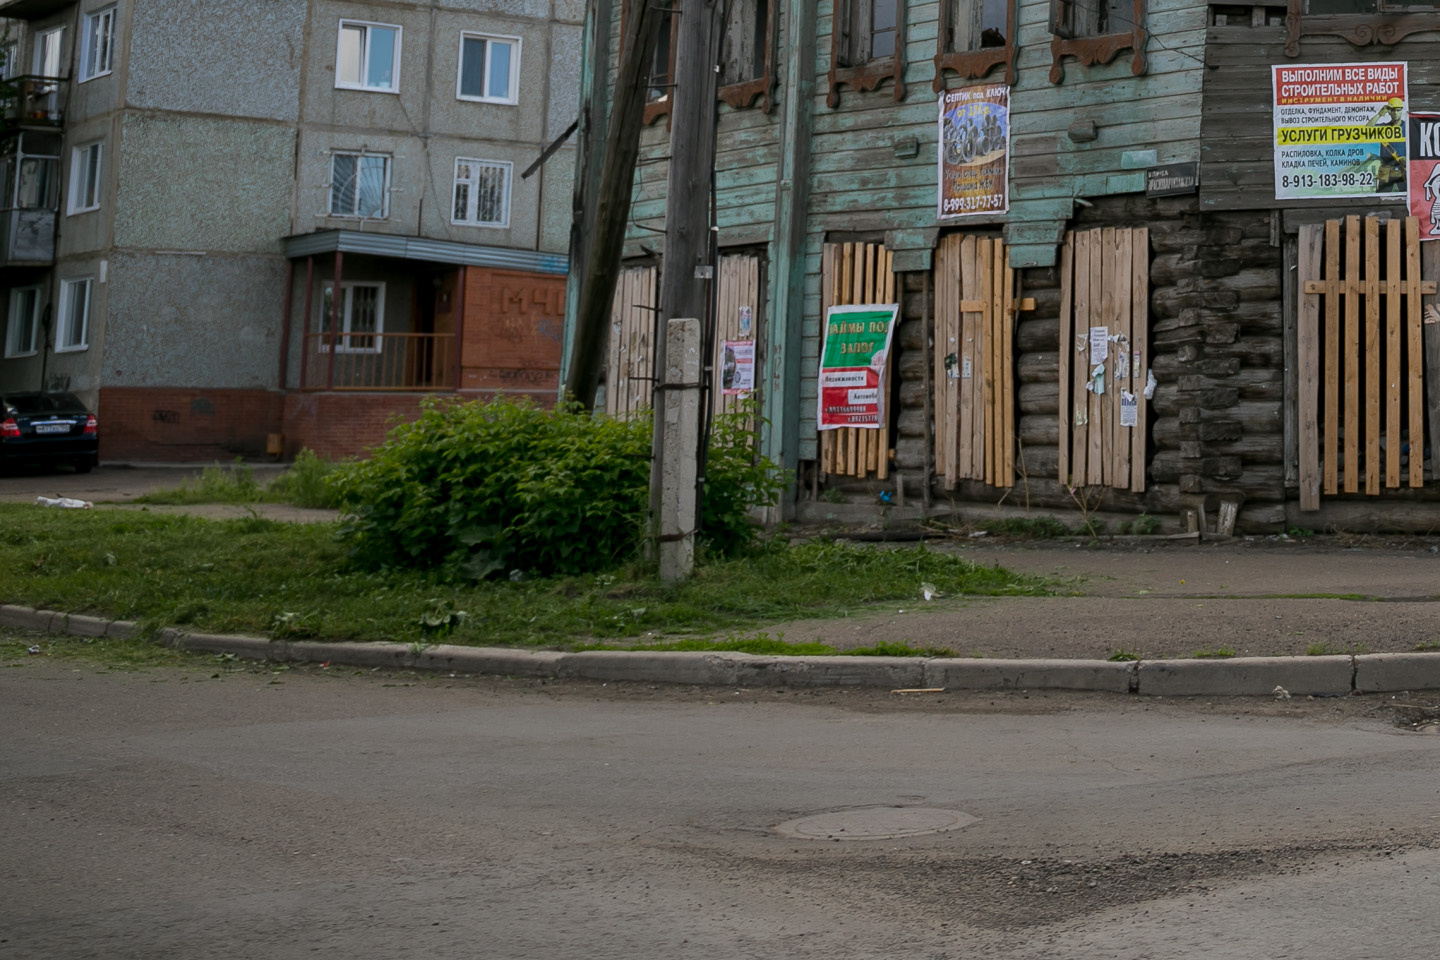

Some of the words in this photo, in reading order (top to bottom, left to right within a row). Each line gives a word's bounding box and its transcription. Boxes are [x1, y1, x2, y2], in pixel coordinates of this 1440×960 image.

[1282, 69, 1342, 82] ВЫПОЛНИМ
[1345, 68, 1364, 80] ВСЕ
[1368, 68, 1398, 81] ВИДЫ
[1282, 83, 1364, 97] СТРОИТЕЛЬНЫХ
[1366, 82, 1399, 94] РАБОТ
[946, 92, 970, 103] СЕПТИК
[1280, 108, 1306, 116] ОТДЕЛКА,
[1308, 106, 1342, 115] ФУНДАМЕНТ,
[1344, 106, 1376, 114] ДЕМОНТАЖ,
[1302, 116, 1346, 124] СТРОИТЕЛЬНОГО
[1282, 129, 1327, 142] УСЛУГИ
[1332, 126, 1402, 140] ГРУЗЧИКОВ
[1282, 150, 1324, 158] РАСПИЛОВКА,
[1348, 148, 1364, 157] ДРОВ
[1282, 161, 1306, 169] КЛАДКА
[1308, 158, 1328, 168] ПЕЧЕЙ,
[1282, 173, 1372, 188] 8-913-183-98-22
[841, 342, 874, 354] ЗАЛОГ
